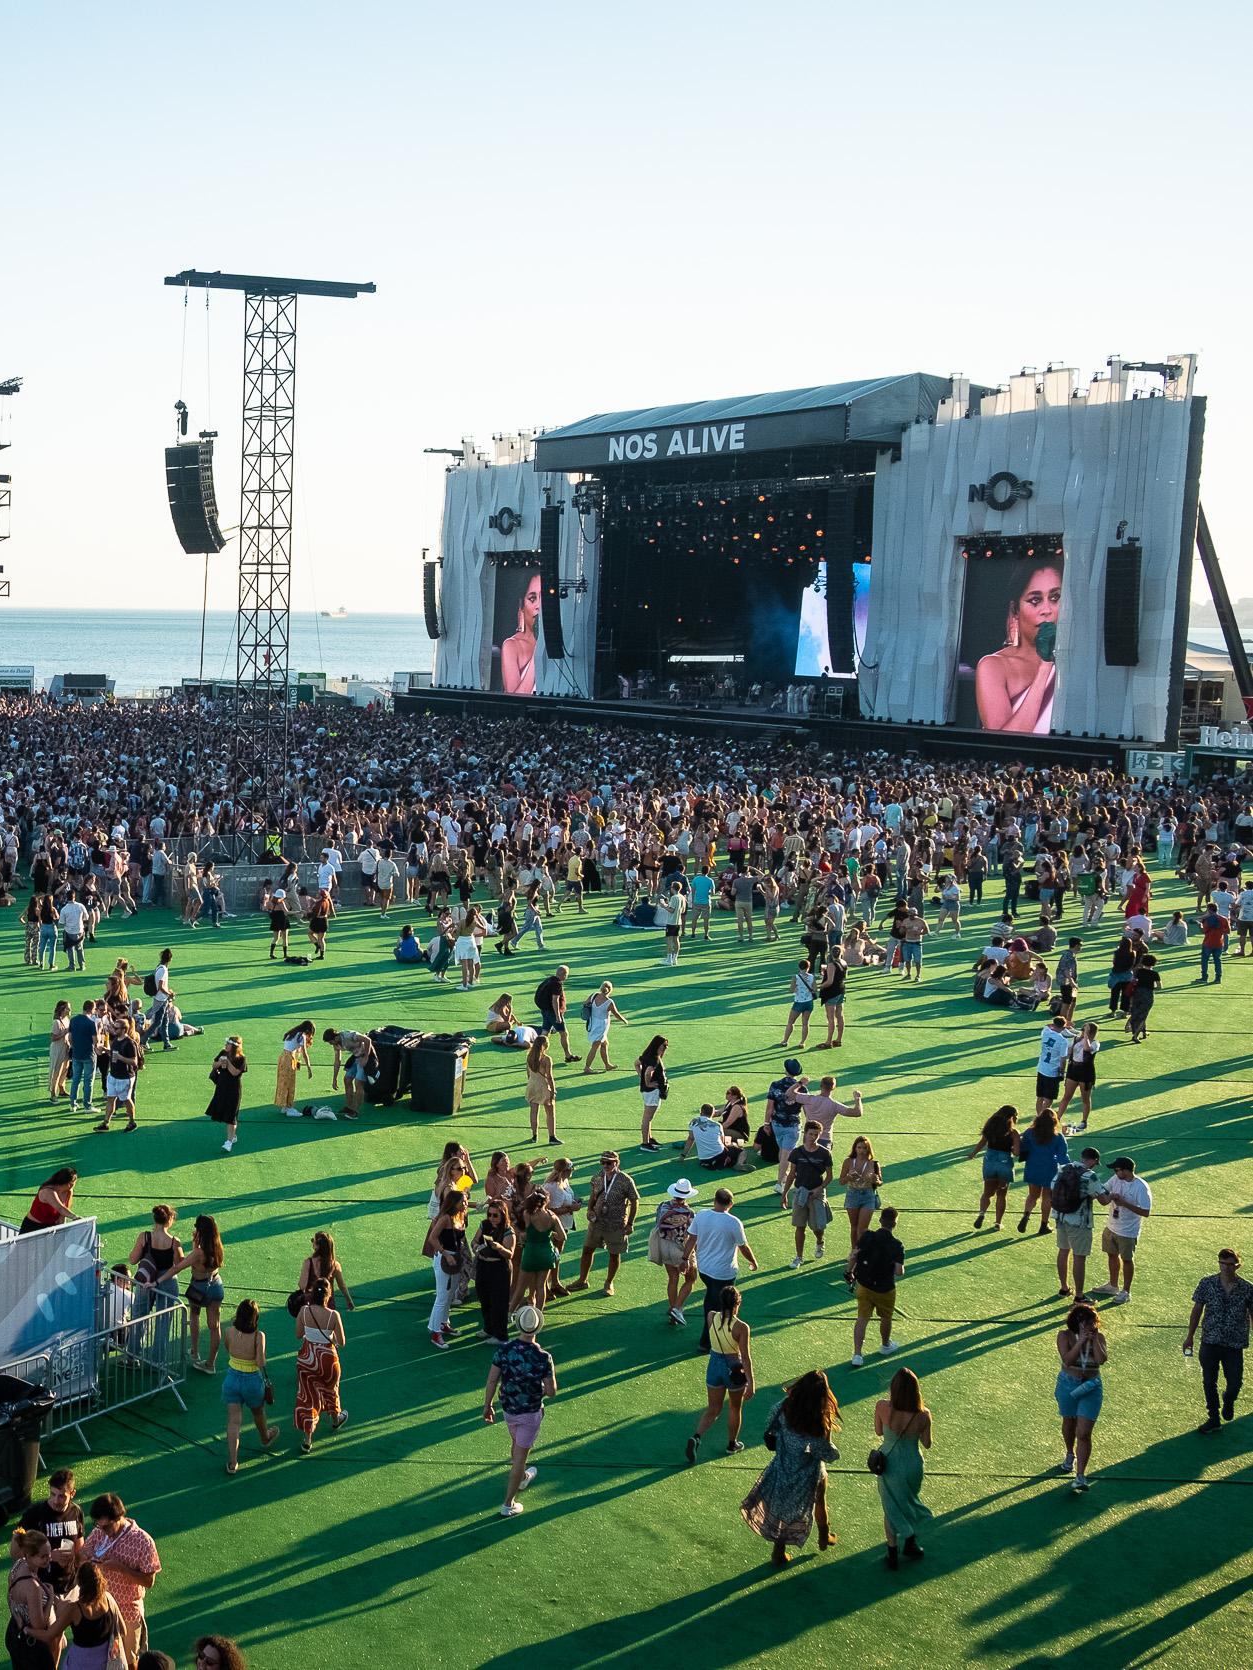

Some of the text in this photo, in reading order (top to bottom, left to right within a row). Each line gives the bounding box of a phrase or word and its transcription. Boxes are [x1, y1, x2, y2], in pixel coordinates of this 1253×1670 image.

[608, 423, 745, 462] NOS ALIVE
[968, 471, 1033, 511] NOS
[489, 506, 521, 535] NOS
[50, 1522, 63, 1537] NEW
